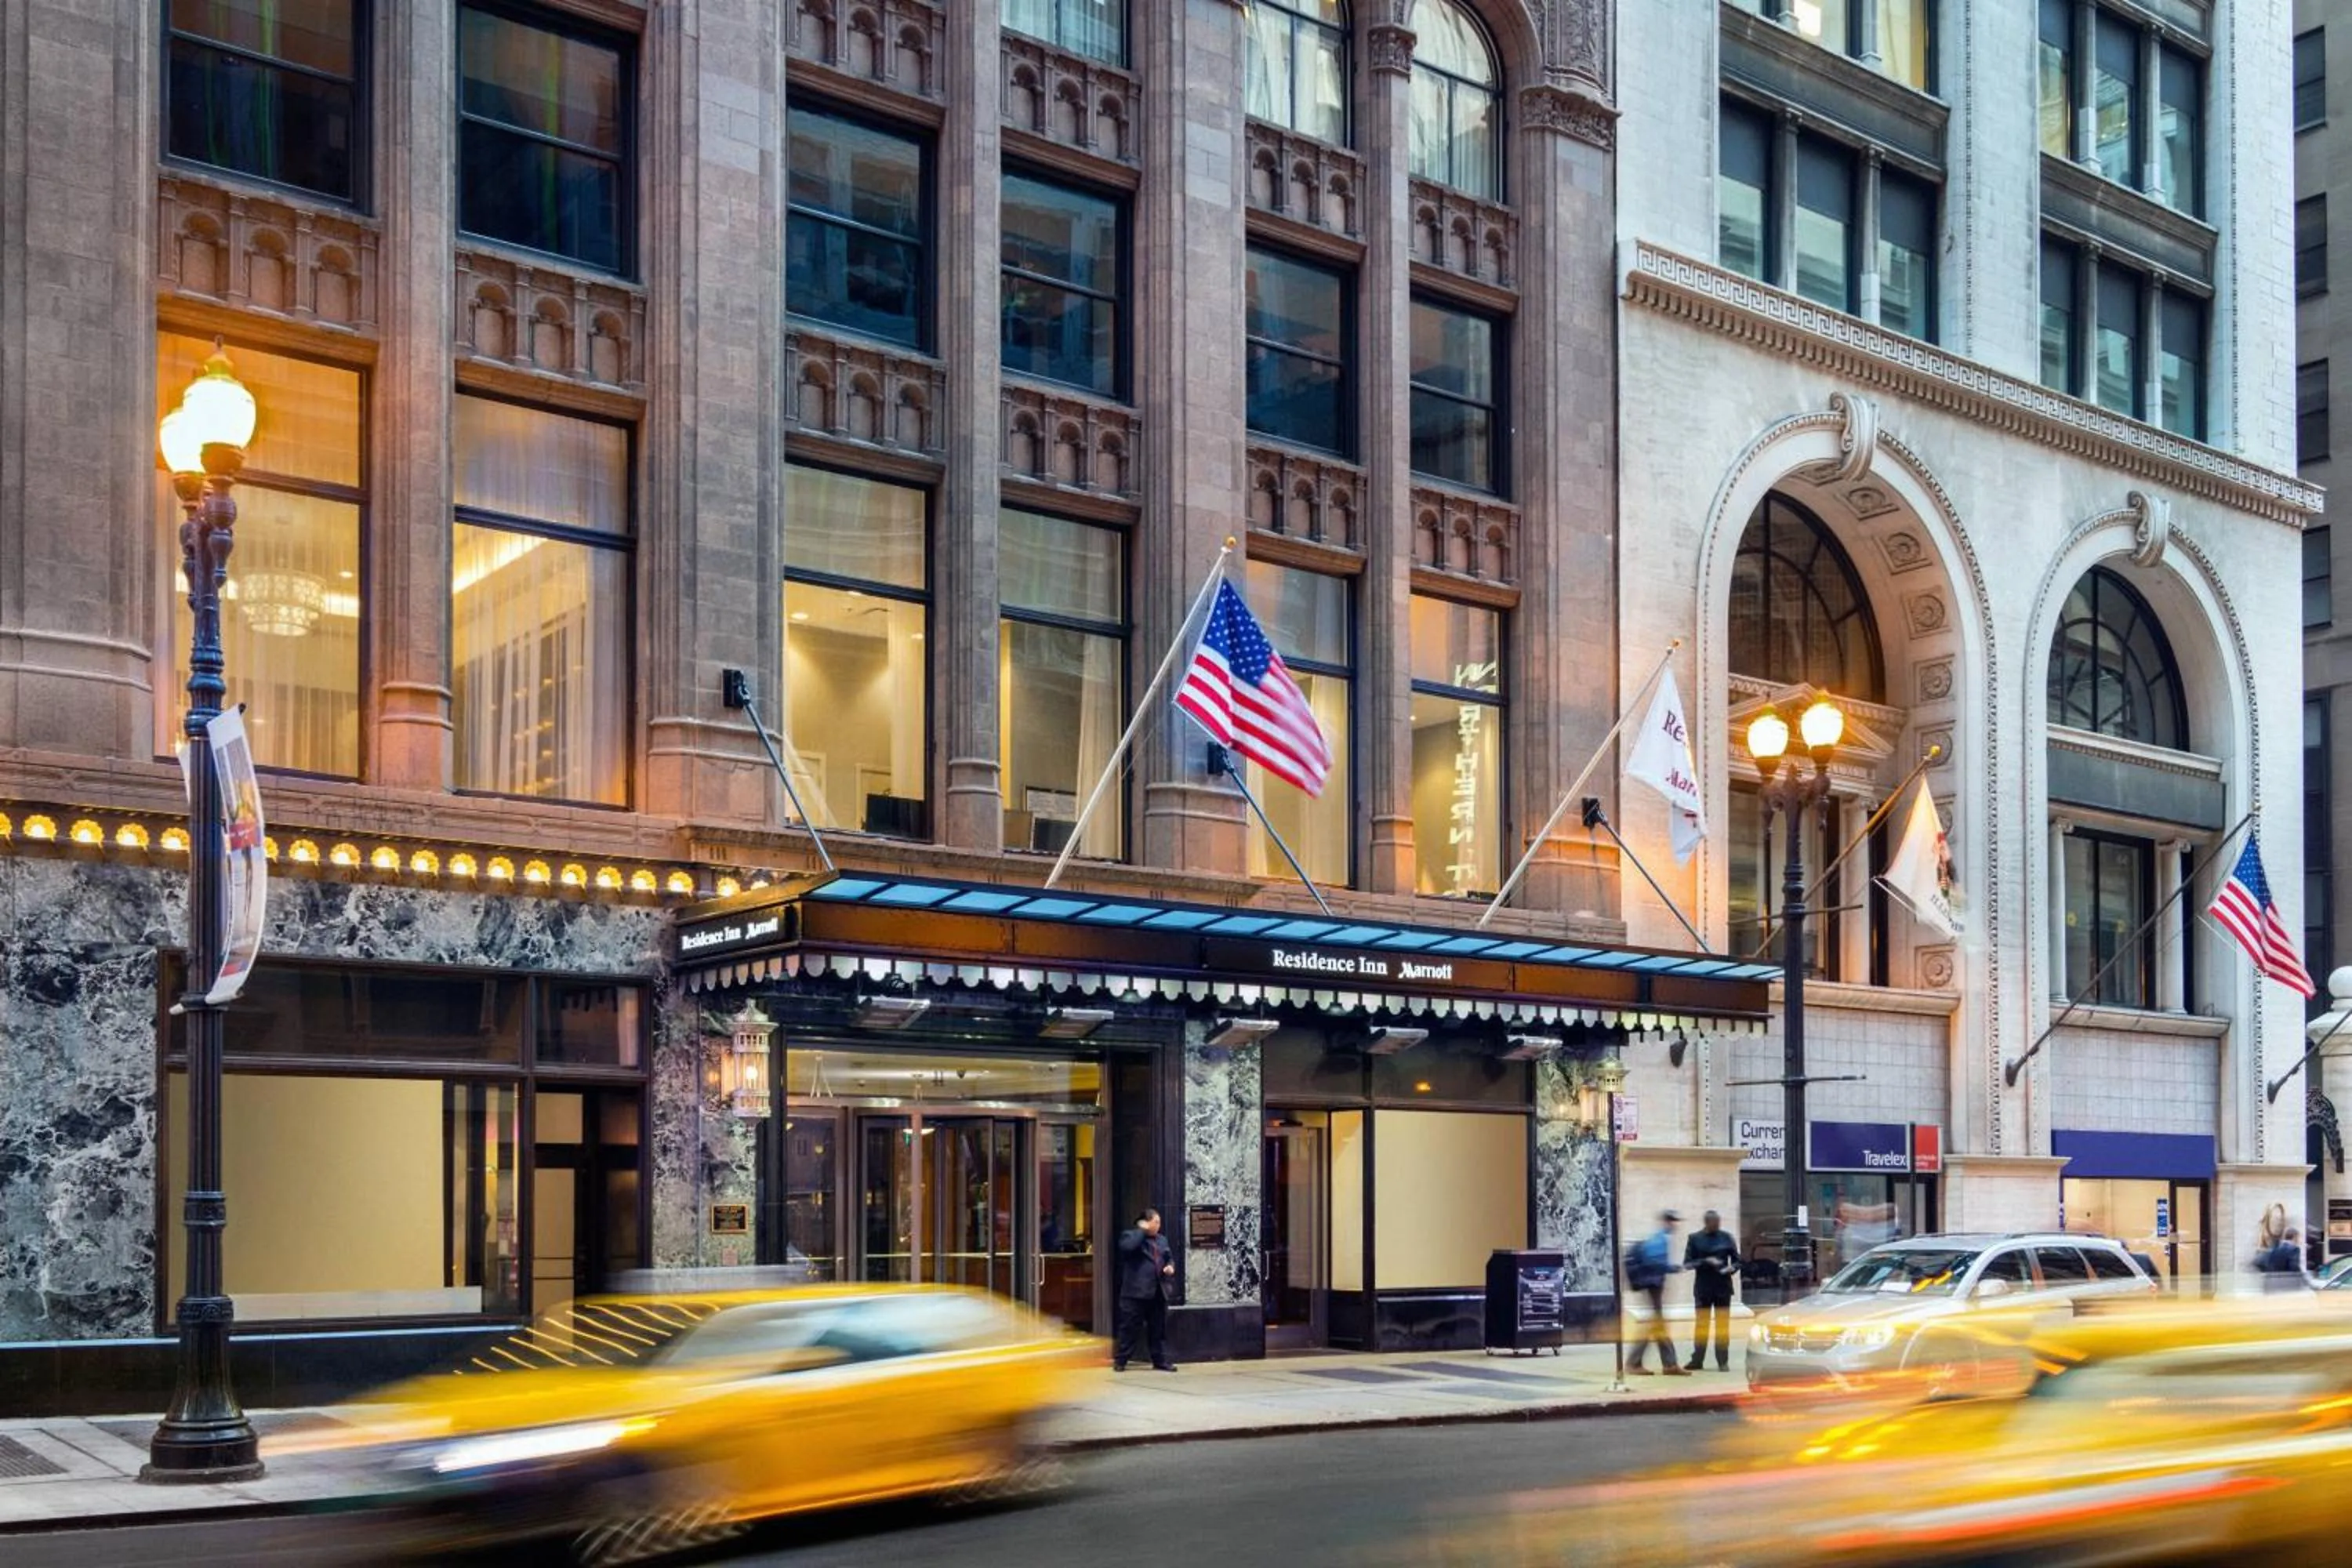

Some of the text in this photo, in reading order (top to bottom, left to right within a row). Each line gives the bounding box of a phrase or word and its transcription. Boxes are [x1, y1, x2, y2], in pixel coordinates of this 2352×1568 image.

[1662, 710, 1687, 745] Re
[681, 931, 724, 951] Residence
[724, 926, 741, 941] Inn
[1272, 949, 1453, 979] Residence Inn Marriott
[1741, 1142, 1787, 1160] xchan
[1862, 1149, 1906, 1166] Travelex
